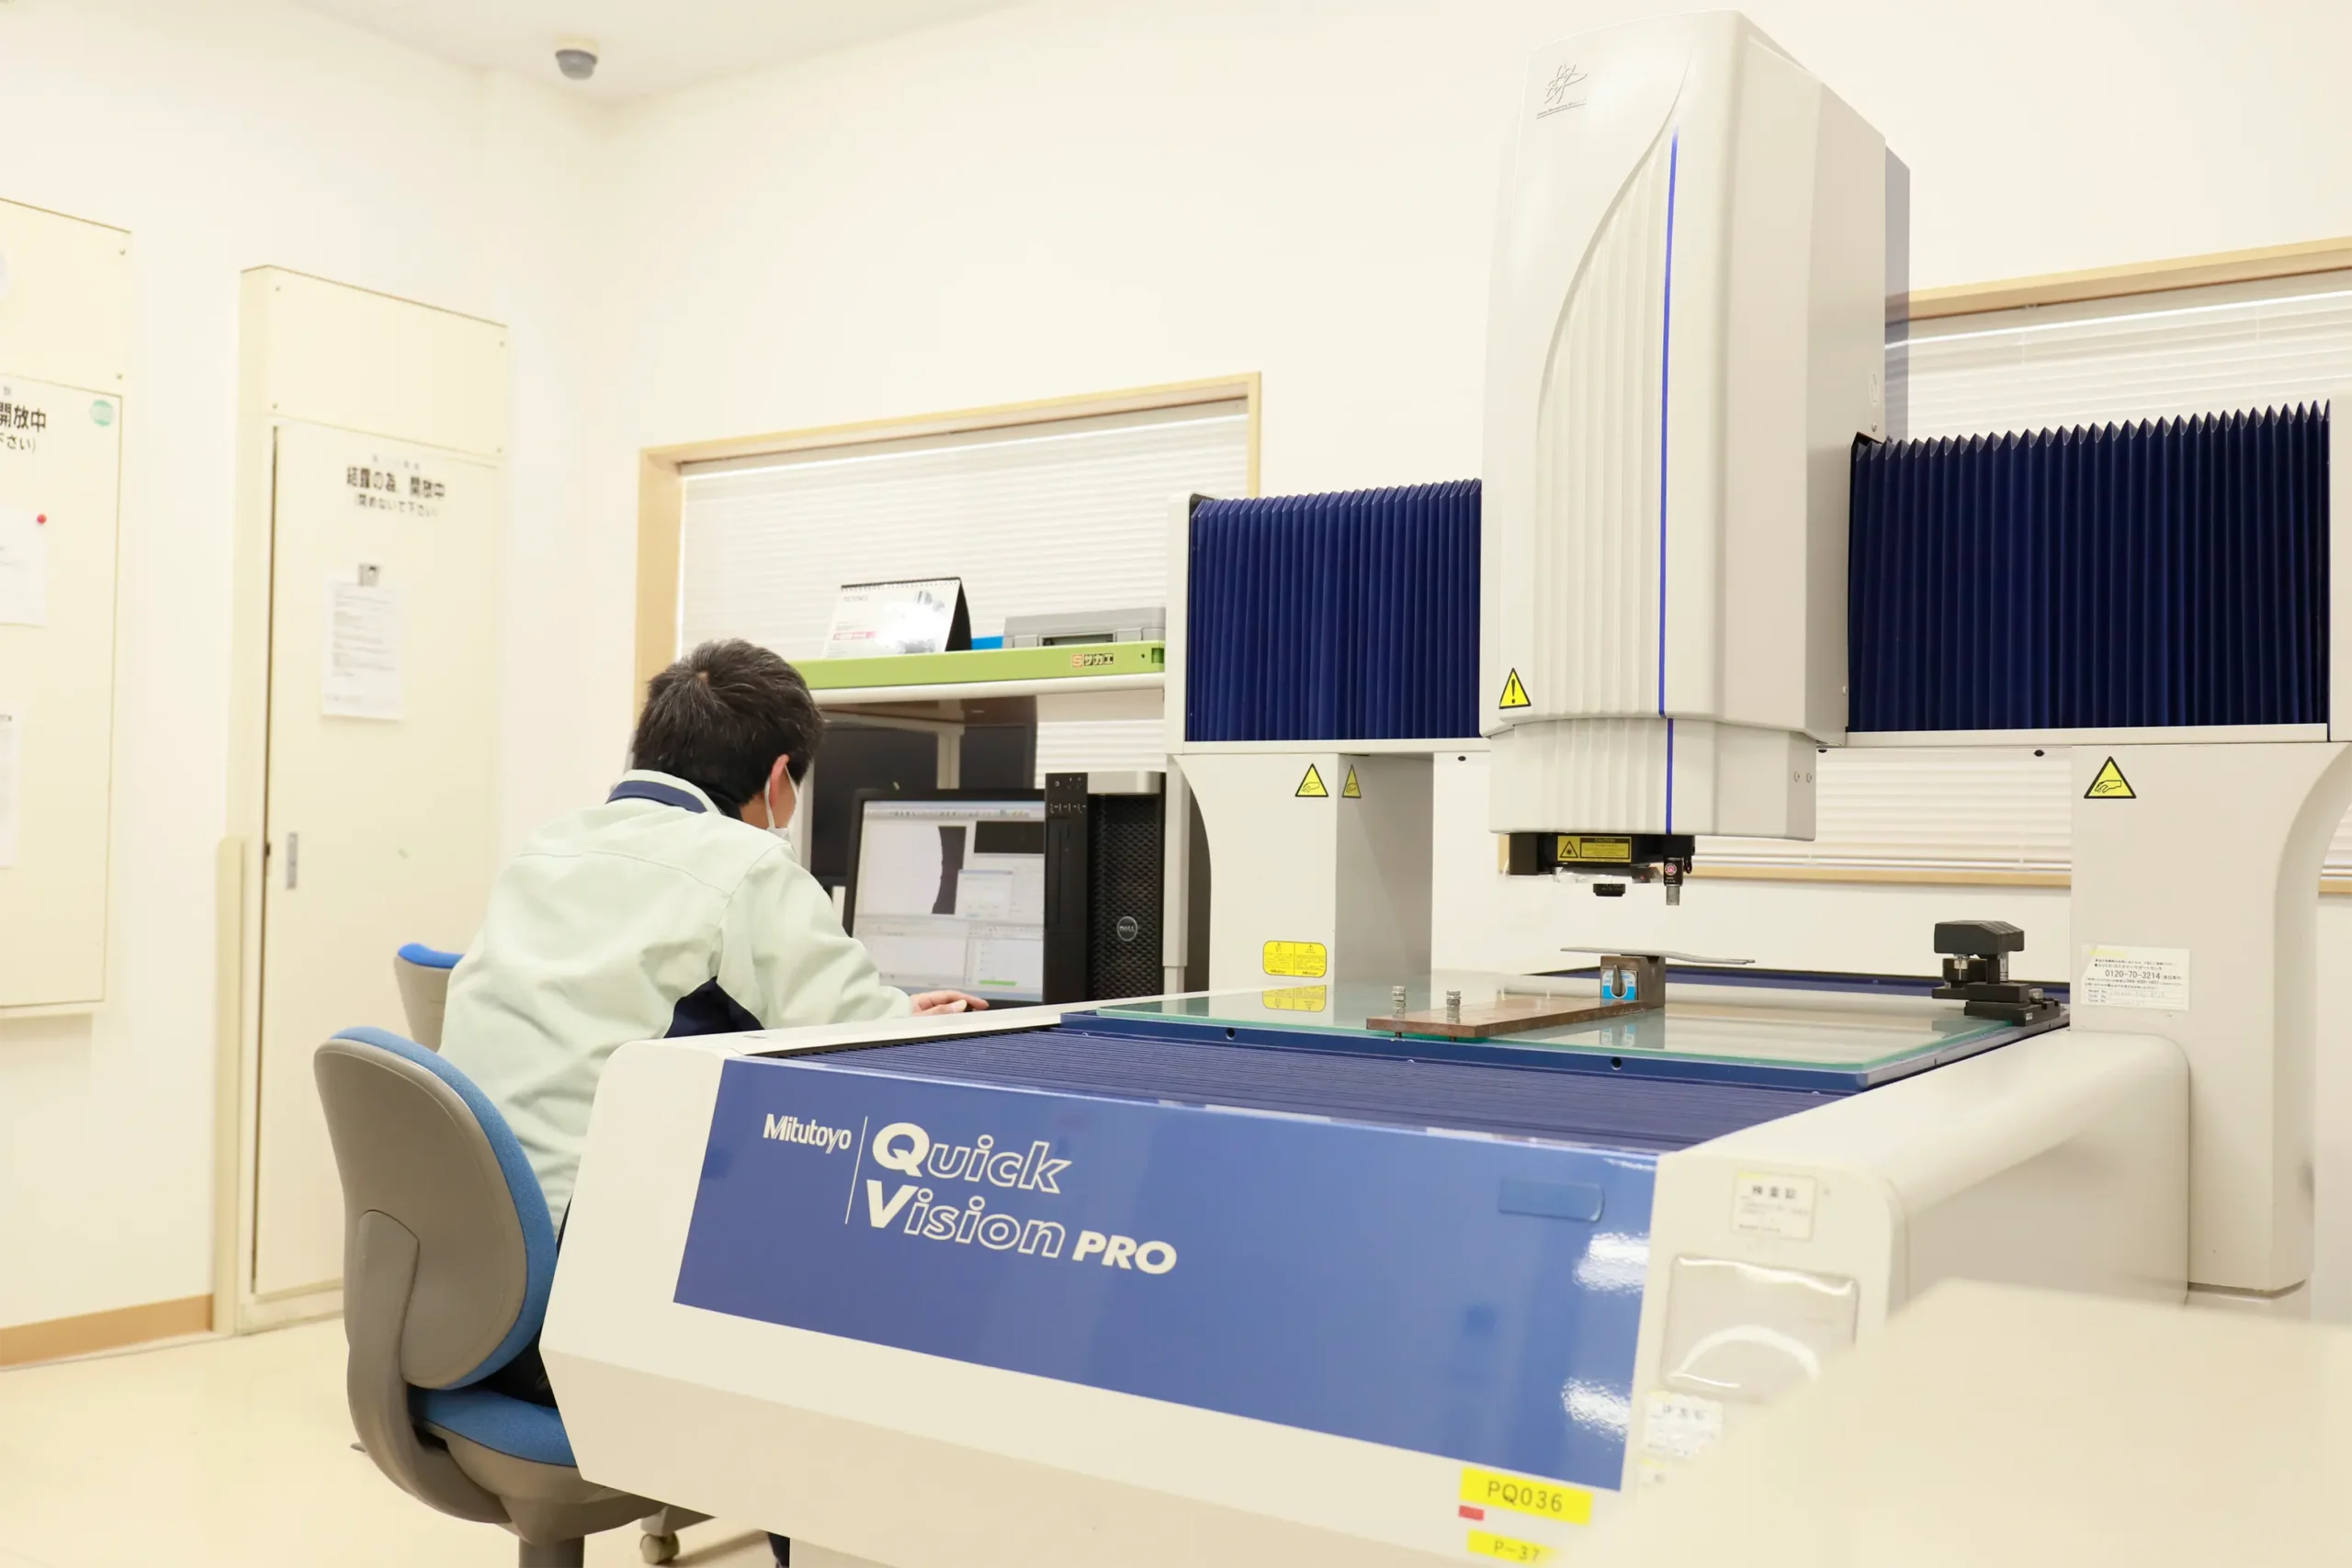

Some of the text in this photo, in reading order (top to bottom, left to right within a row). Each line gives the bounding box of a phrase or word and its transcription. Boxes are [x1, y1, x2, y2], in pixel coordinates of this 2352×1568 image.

[2105, 969, 2161, 980] 0120-70-3214
[763, 1113, 852, 1154] Mitutoyo
[873, 1122, 1072, 1194] Quick
[866, 1179, 1178, 1275] Vision PRO
[1487, 1480, 1563, 1513] PQ036
[1494, 1539, 1541, 1562] P-37
